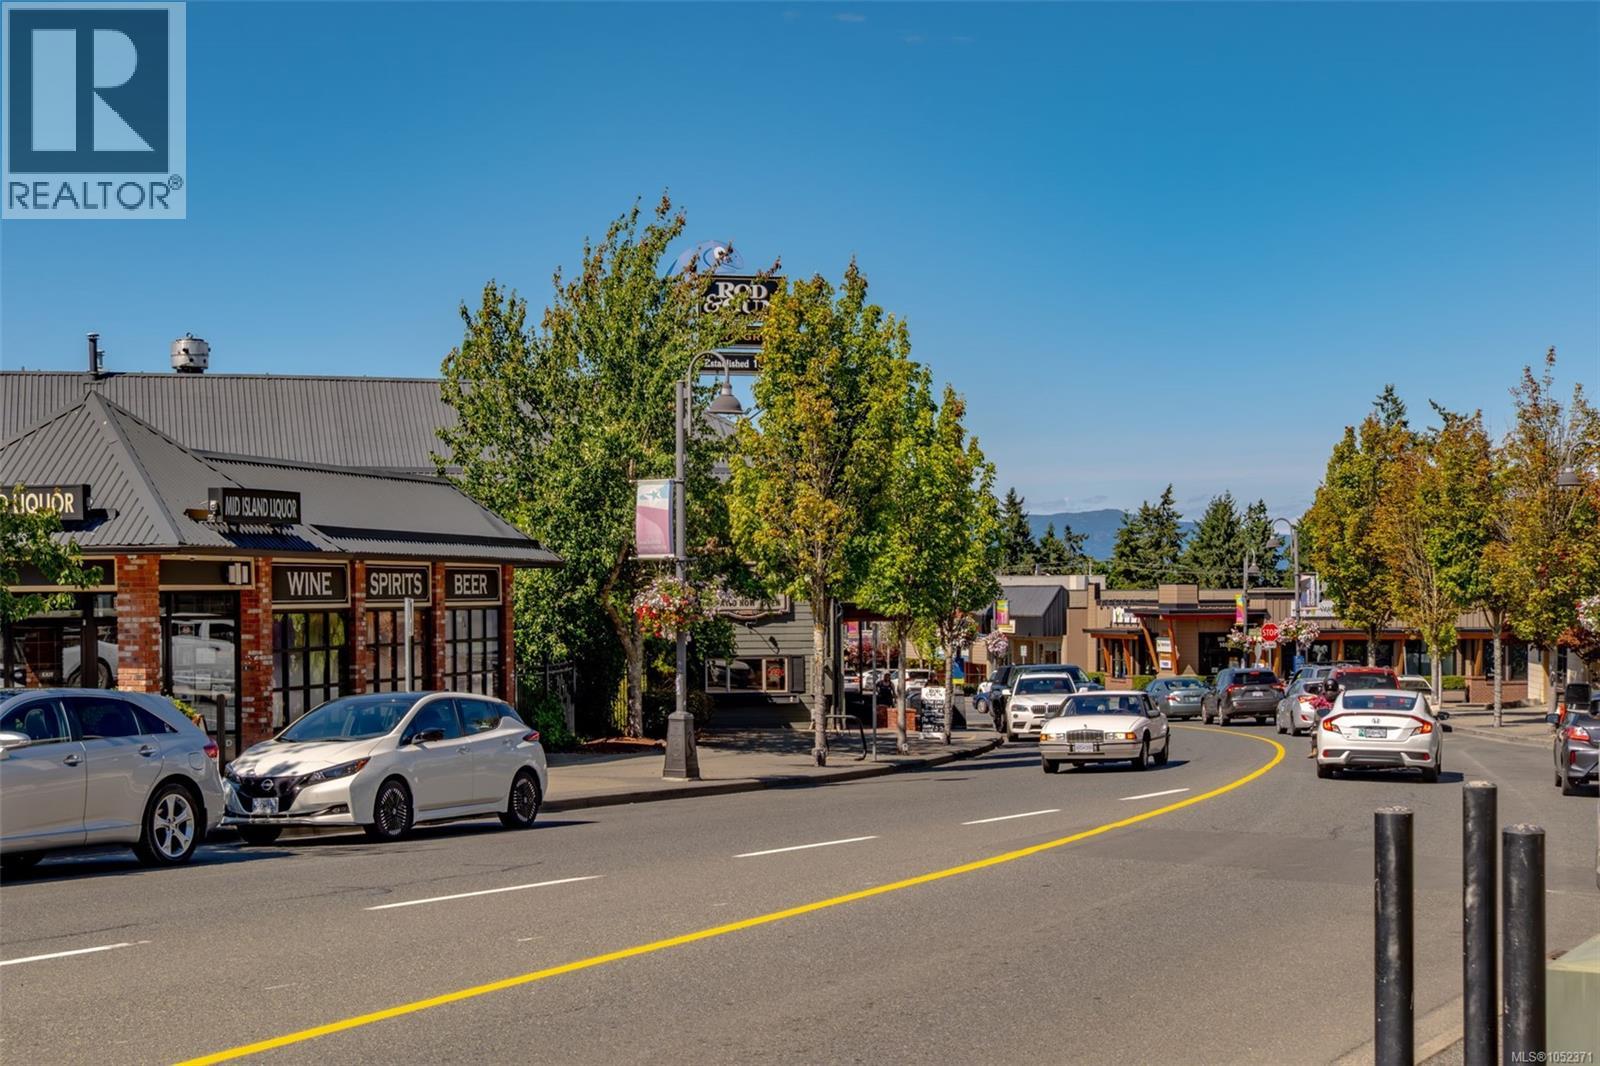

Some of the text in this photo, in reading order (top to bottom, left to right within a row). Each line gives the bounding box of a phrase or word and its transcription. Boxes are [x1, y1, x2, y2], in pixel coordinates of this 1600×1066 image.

[13, 492, 74, 514] LIQUOR
[225, 495, 298, 519] MID ISLAND LIQUOR
[287, 571, 333, 596] WINE
[369, 572, 423, 596] SPIRITS
[454, 573, 488, 595] BEER
[1262, 628, 1279, 637] STOP
